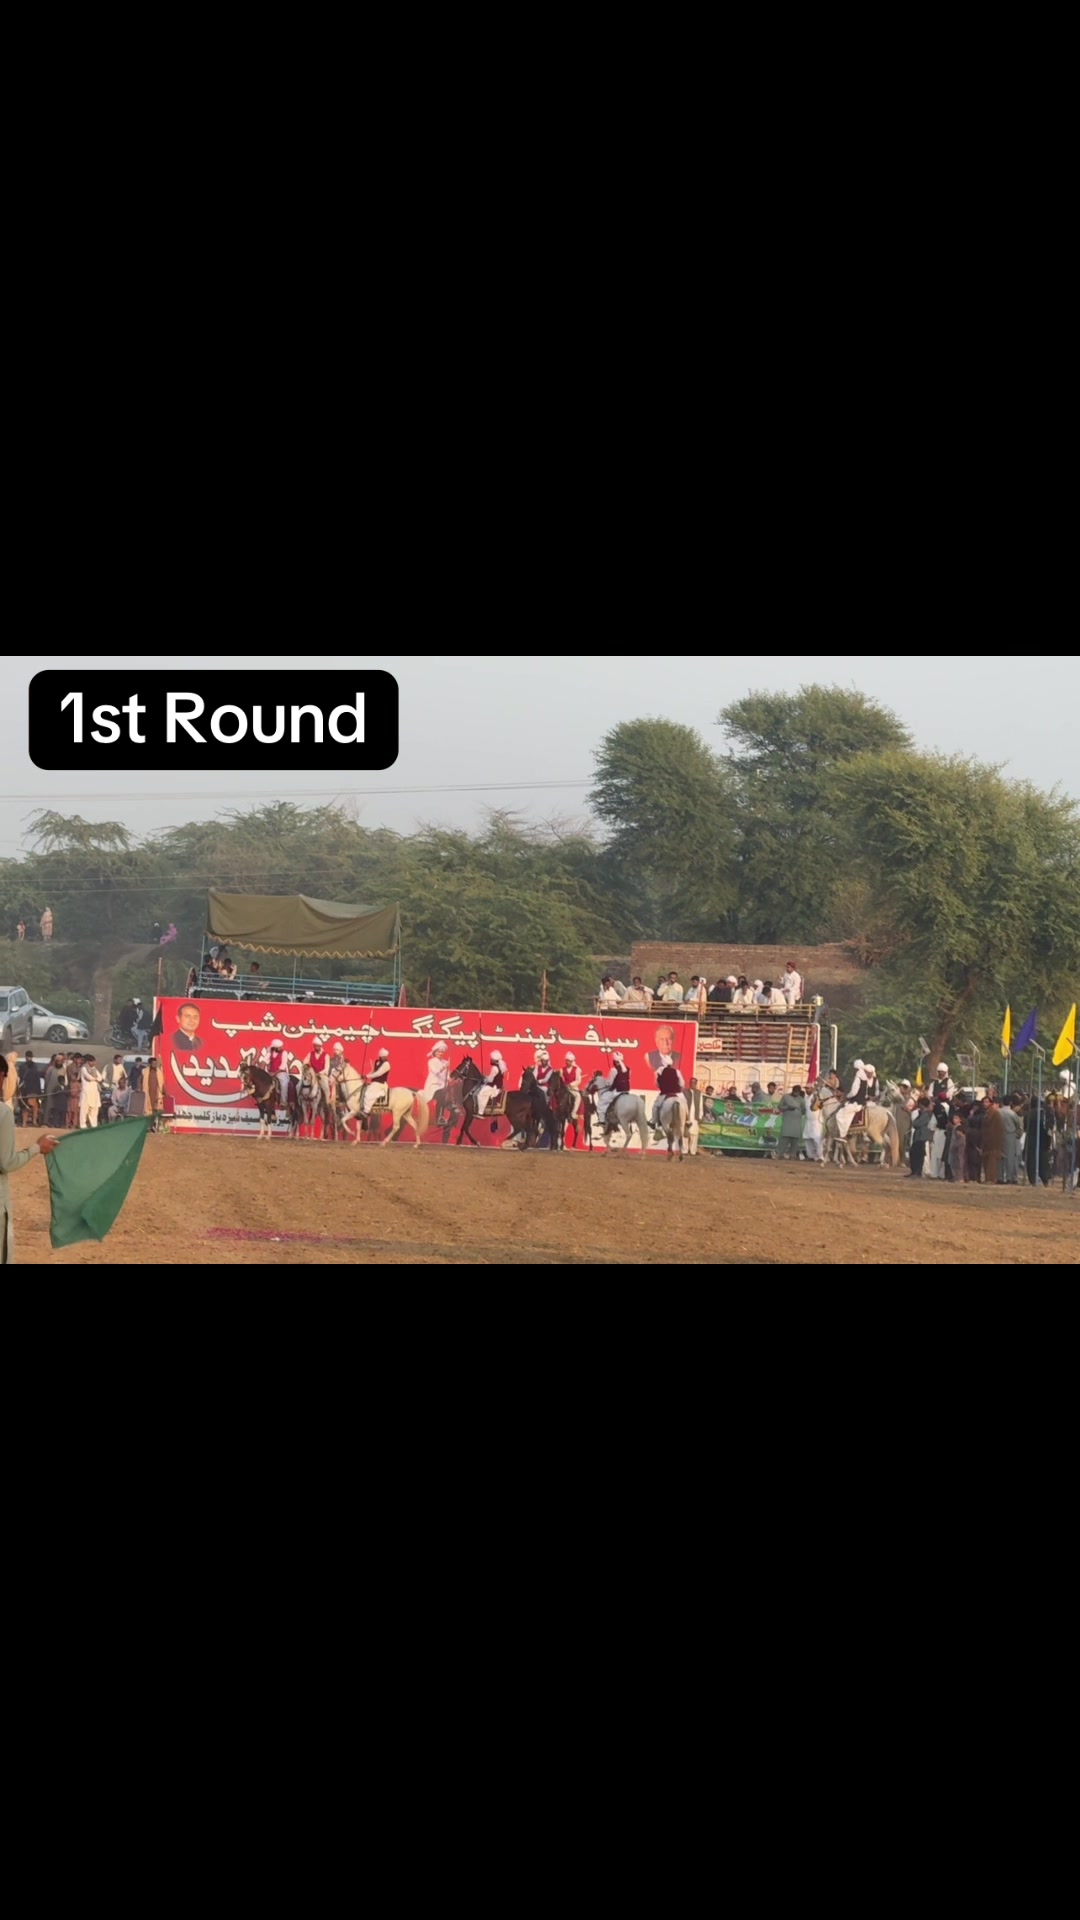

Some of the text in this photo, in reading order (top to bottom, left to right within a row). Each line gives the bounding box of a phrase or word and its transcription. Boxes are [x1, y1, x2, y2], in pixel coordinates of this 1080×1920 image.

[211, 1012, 282, 1038] شپ
[381, 1013, 479, 1048] پیگنگ
[479, 1025, 557, 1050] ٹینٹ
[558, 1024, 639, 1053] سیف
